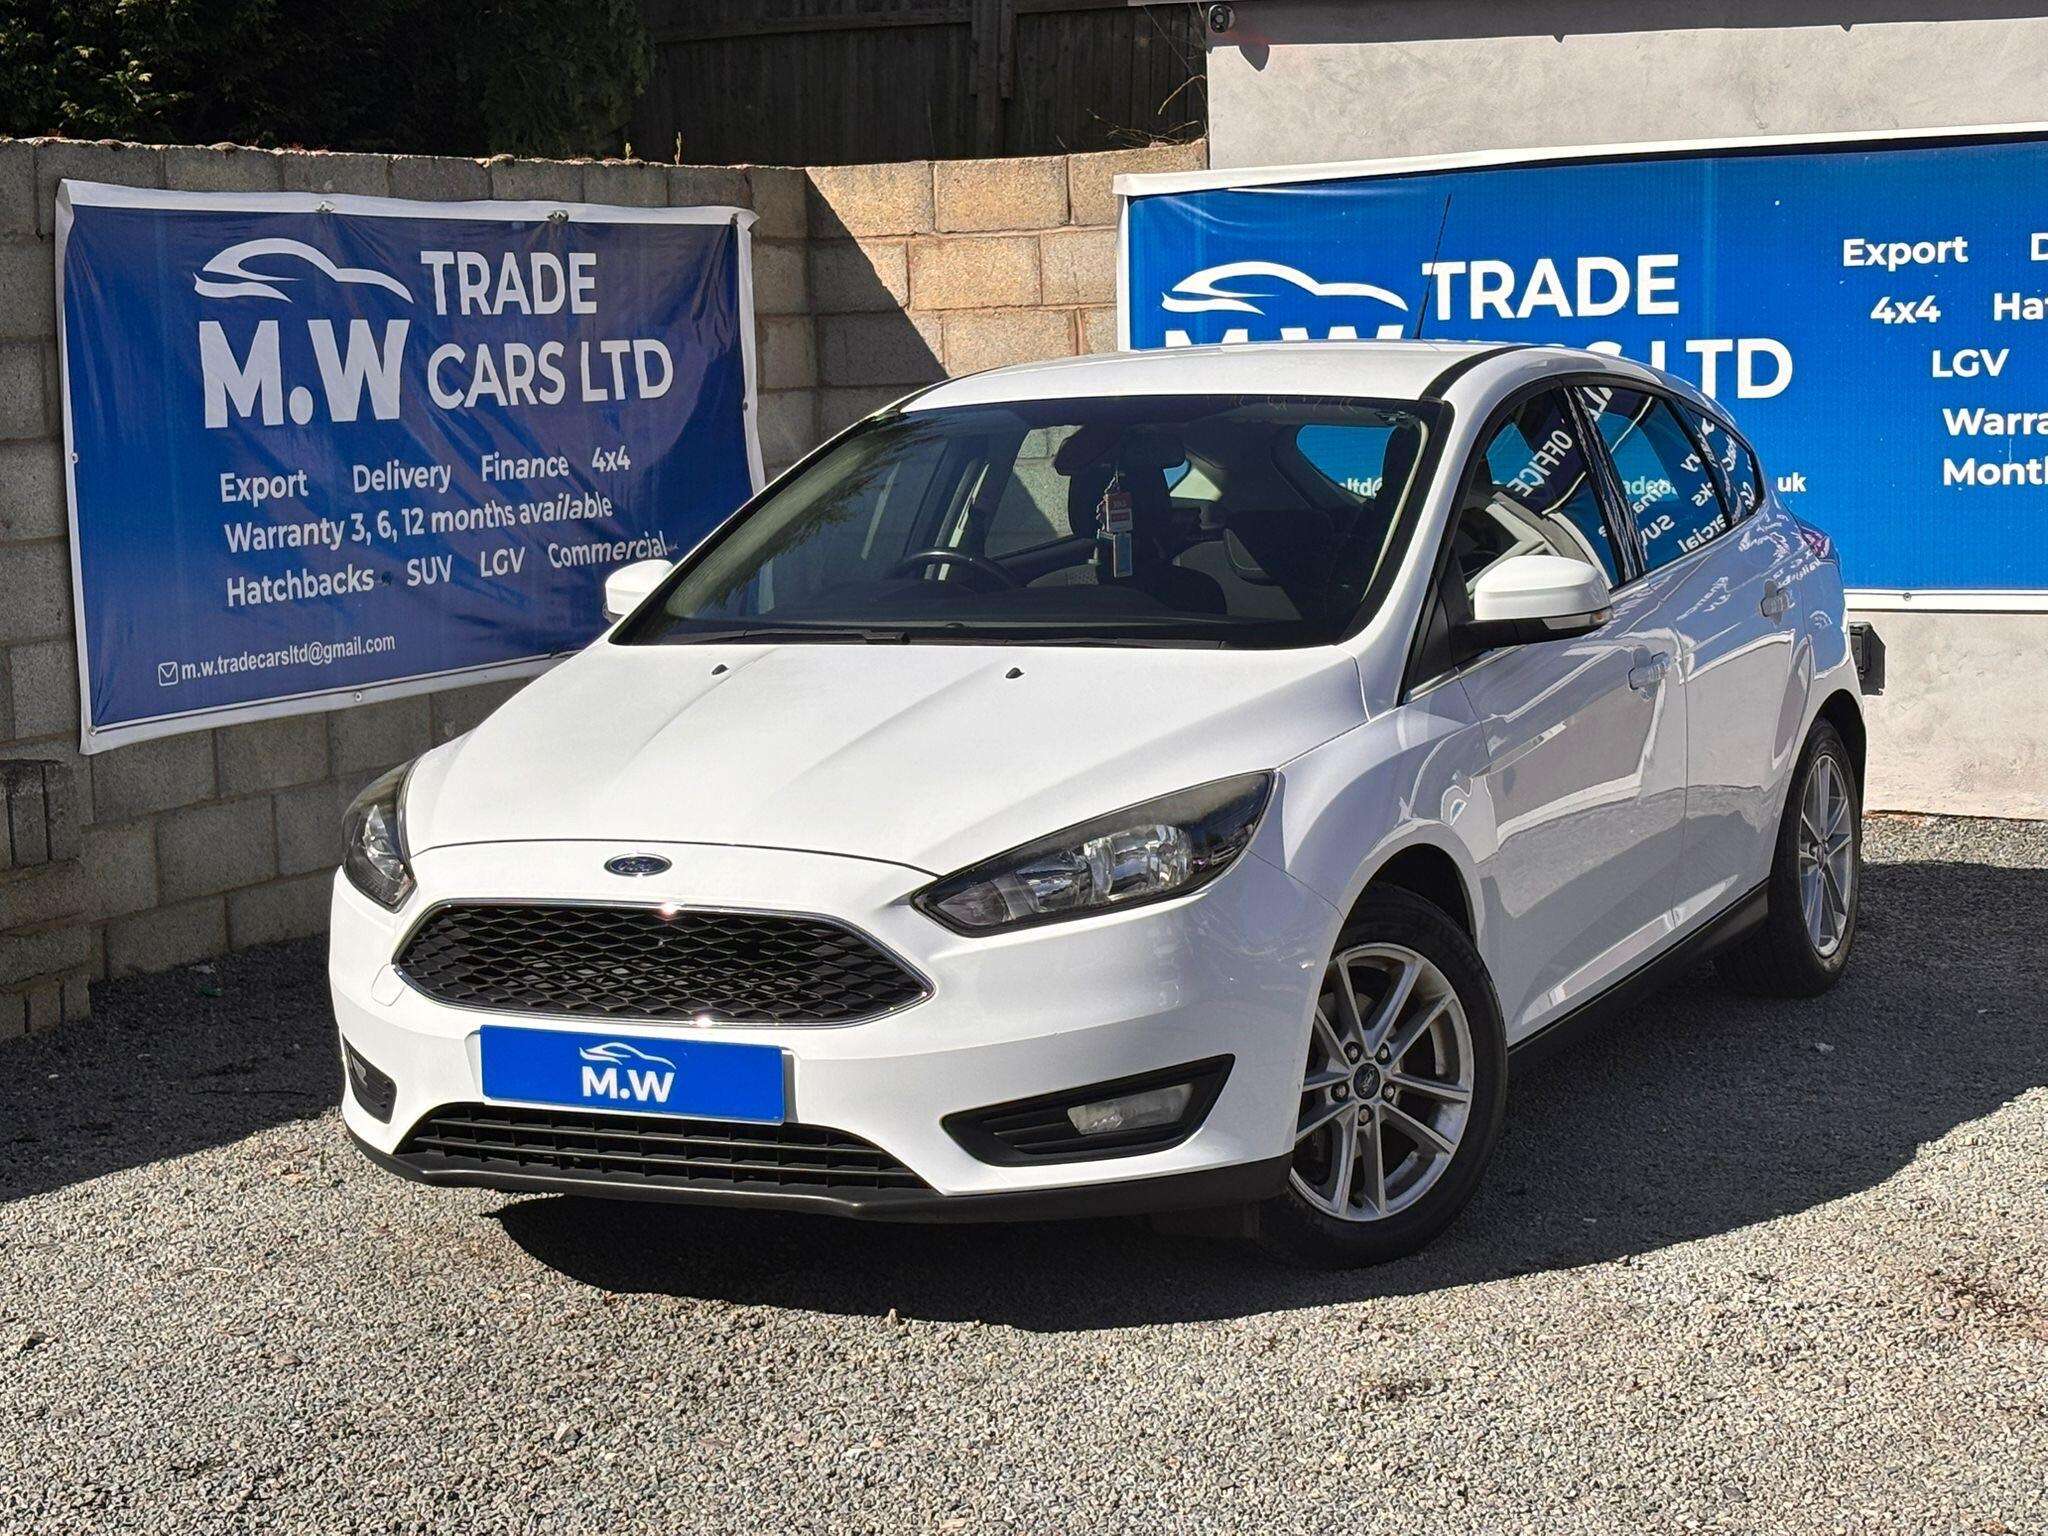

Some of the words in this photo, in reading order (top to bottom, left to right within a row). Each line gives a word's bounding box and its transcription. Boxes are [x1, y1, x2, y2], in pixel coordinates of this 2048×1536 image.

[420, 250, 598, 316] TRADE
[1842, 236, 1969, 272] Export
[1421, 253, 1681, 321] TRADE
[1870, 295, 1942, 324] 4x4
[199, 319, 411, 429] M.W
[426, 340, 566, 410] CARS
[580, 338, 675, 403] LTD
[1931, 348, 2010, 378] LGV
[219, 469, 309, 508] Export
[352, 459, 451, 494] Delivery
[481, 451, 569, 482] Finance
[591, 445, 632, 473] 4x4
[1776, 472, 1807, 492] uk
[223, 518, 346, 553] Warranty
[350, 512, 372, 546] 3,
[376, 510, 398, 546] 6,
[401, 507, 425, 536] 12
[431, 499, 516, 534] months
[519, 491, 614, 525] available
[226, 563, 375, 608] Hatchbacks
[406, 555, 453, 587] SUV
[480, 546, 526, 578] LGV
[547, 530, 668, 570] Commercial
[181, 634, 396, 681] m.w.tradecarsltd@gmail.com
[581, 1066, 675, 1103] M.W
